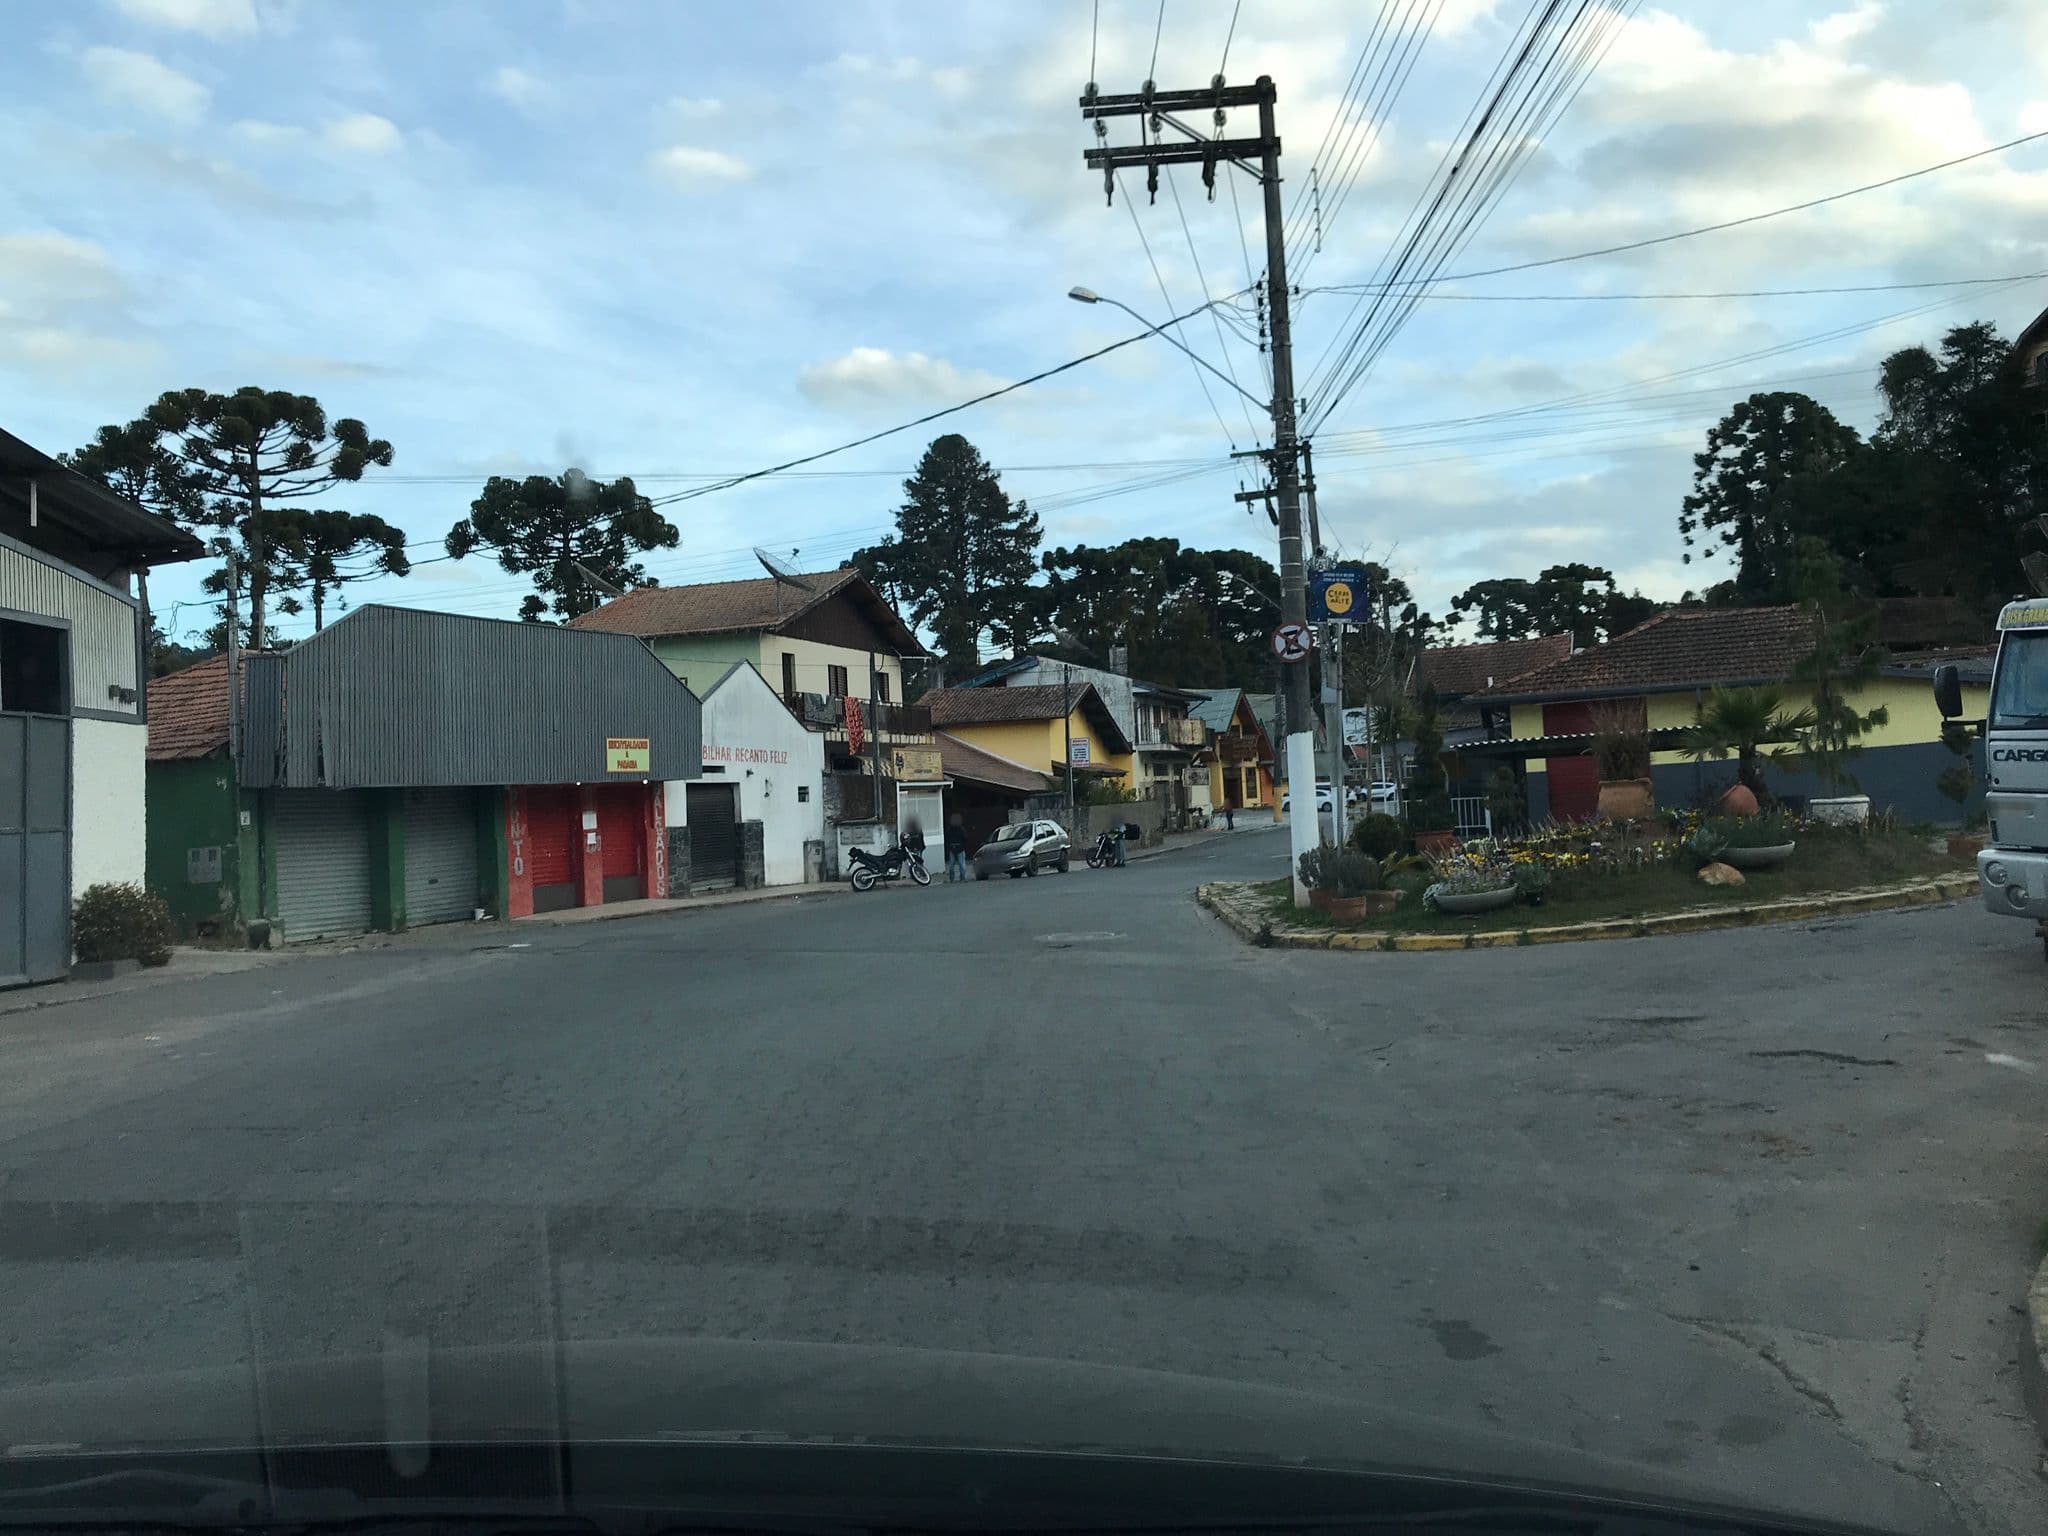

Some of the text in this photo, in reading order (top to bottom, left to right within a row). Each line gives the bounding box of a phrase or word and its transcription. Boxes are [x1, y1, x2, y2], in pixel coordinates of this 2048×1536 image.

[702, 745, 788, 765] BILHAR RECANTO FELIZ
[1993, 749, 2048, 762] CARG
